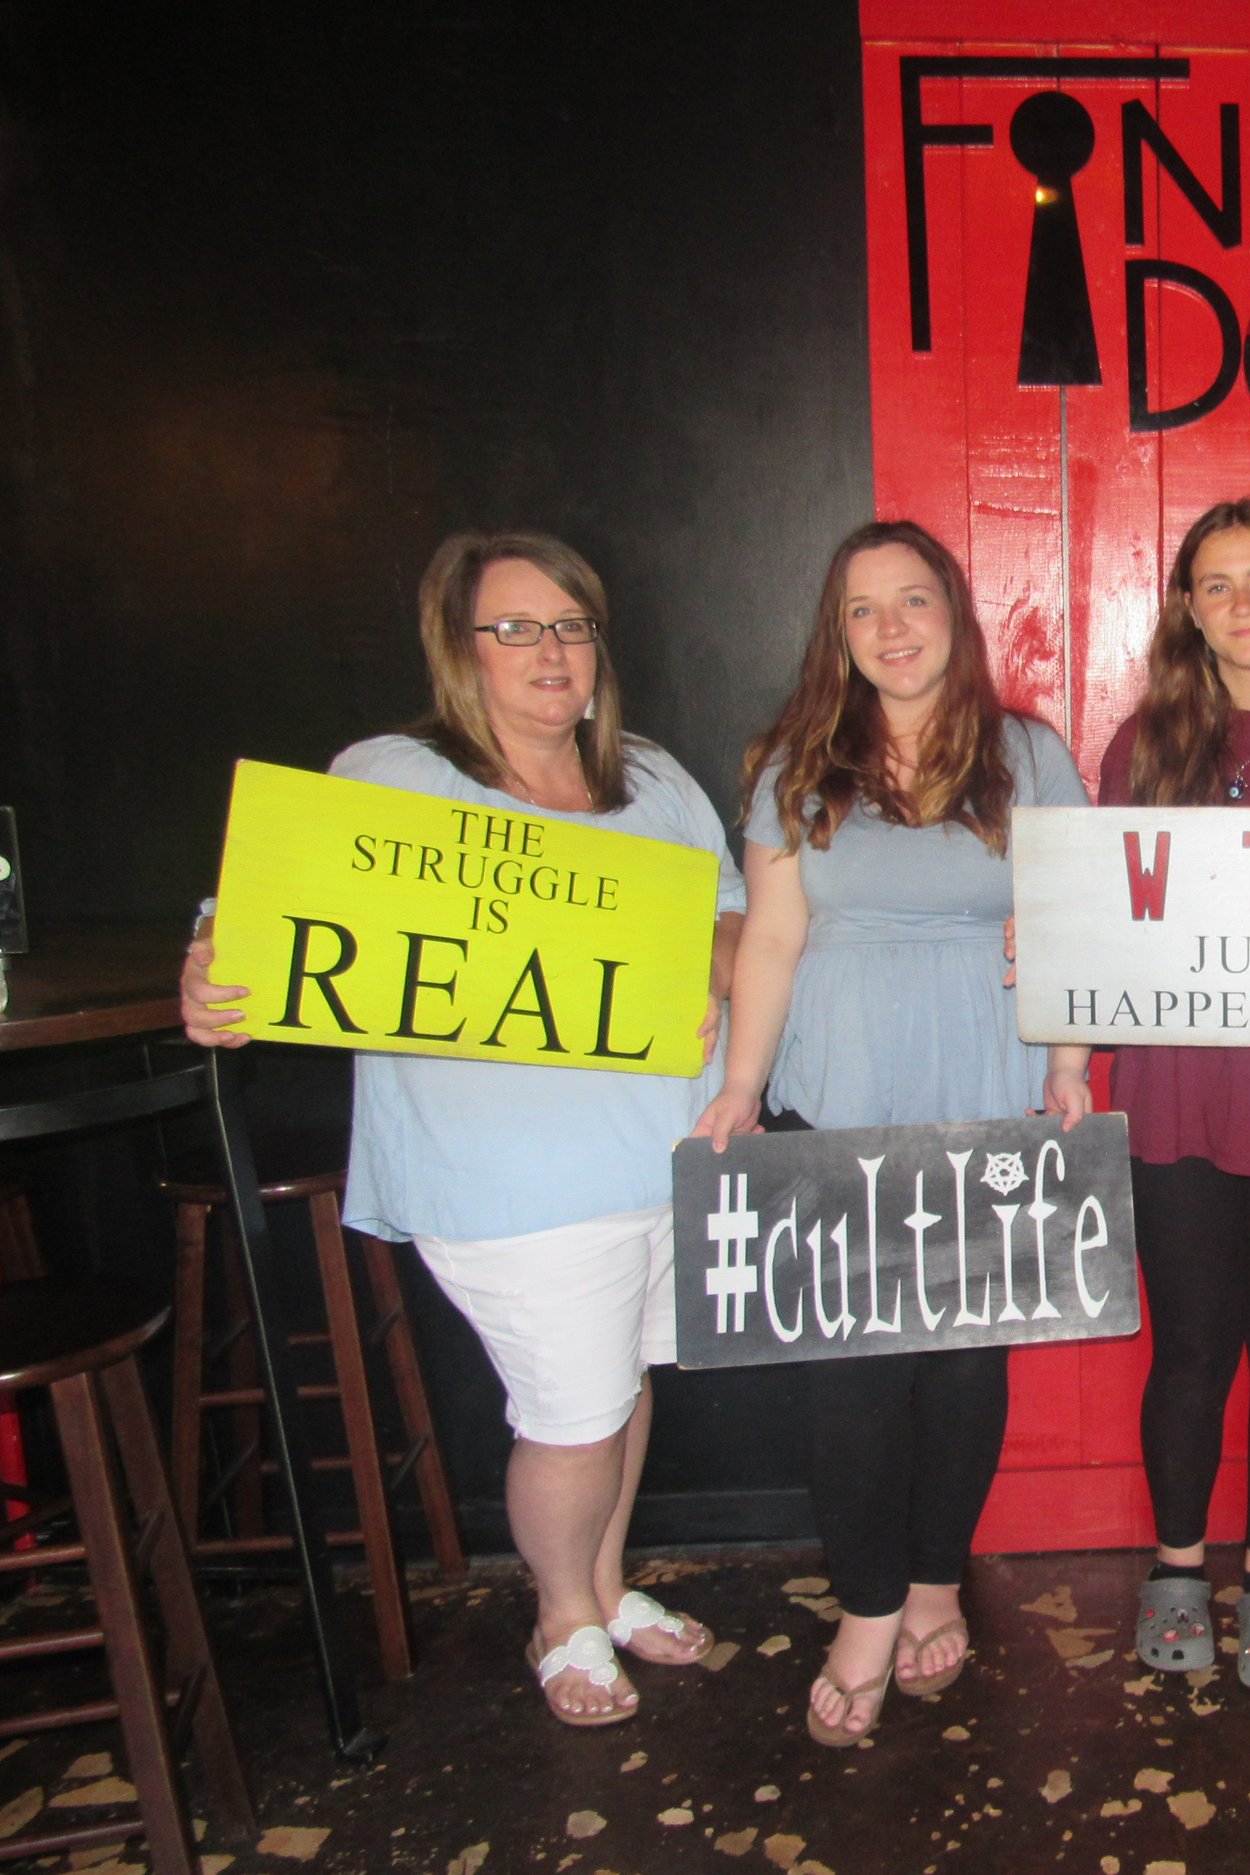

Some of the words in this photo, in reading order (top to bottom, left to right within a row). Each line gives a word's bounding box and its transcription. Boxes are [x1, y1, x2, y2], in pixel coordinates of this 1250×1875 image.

[451, 809, 545, 857] THE
[351, 834, 619, 911] STRUGGLE
[468, 897, 509, 934] IS
[269, 915, 655, 1060] REAL
